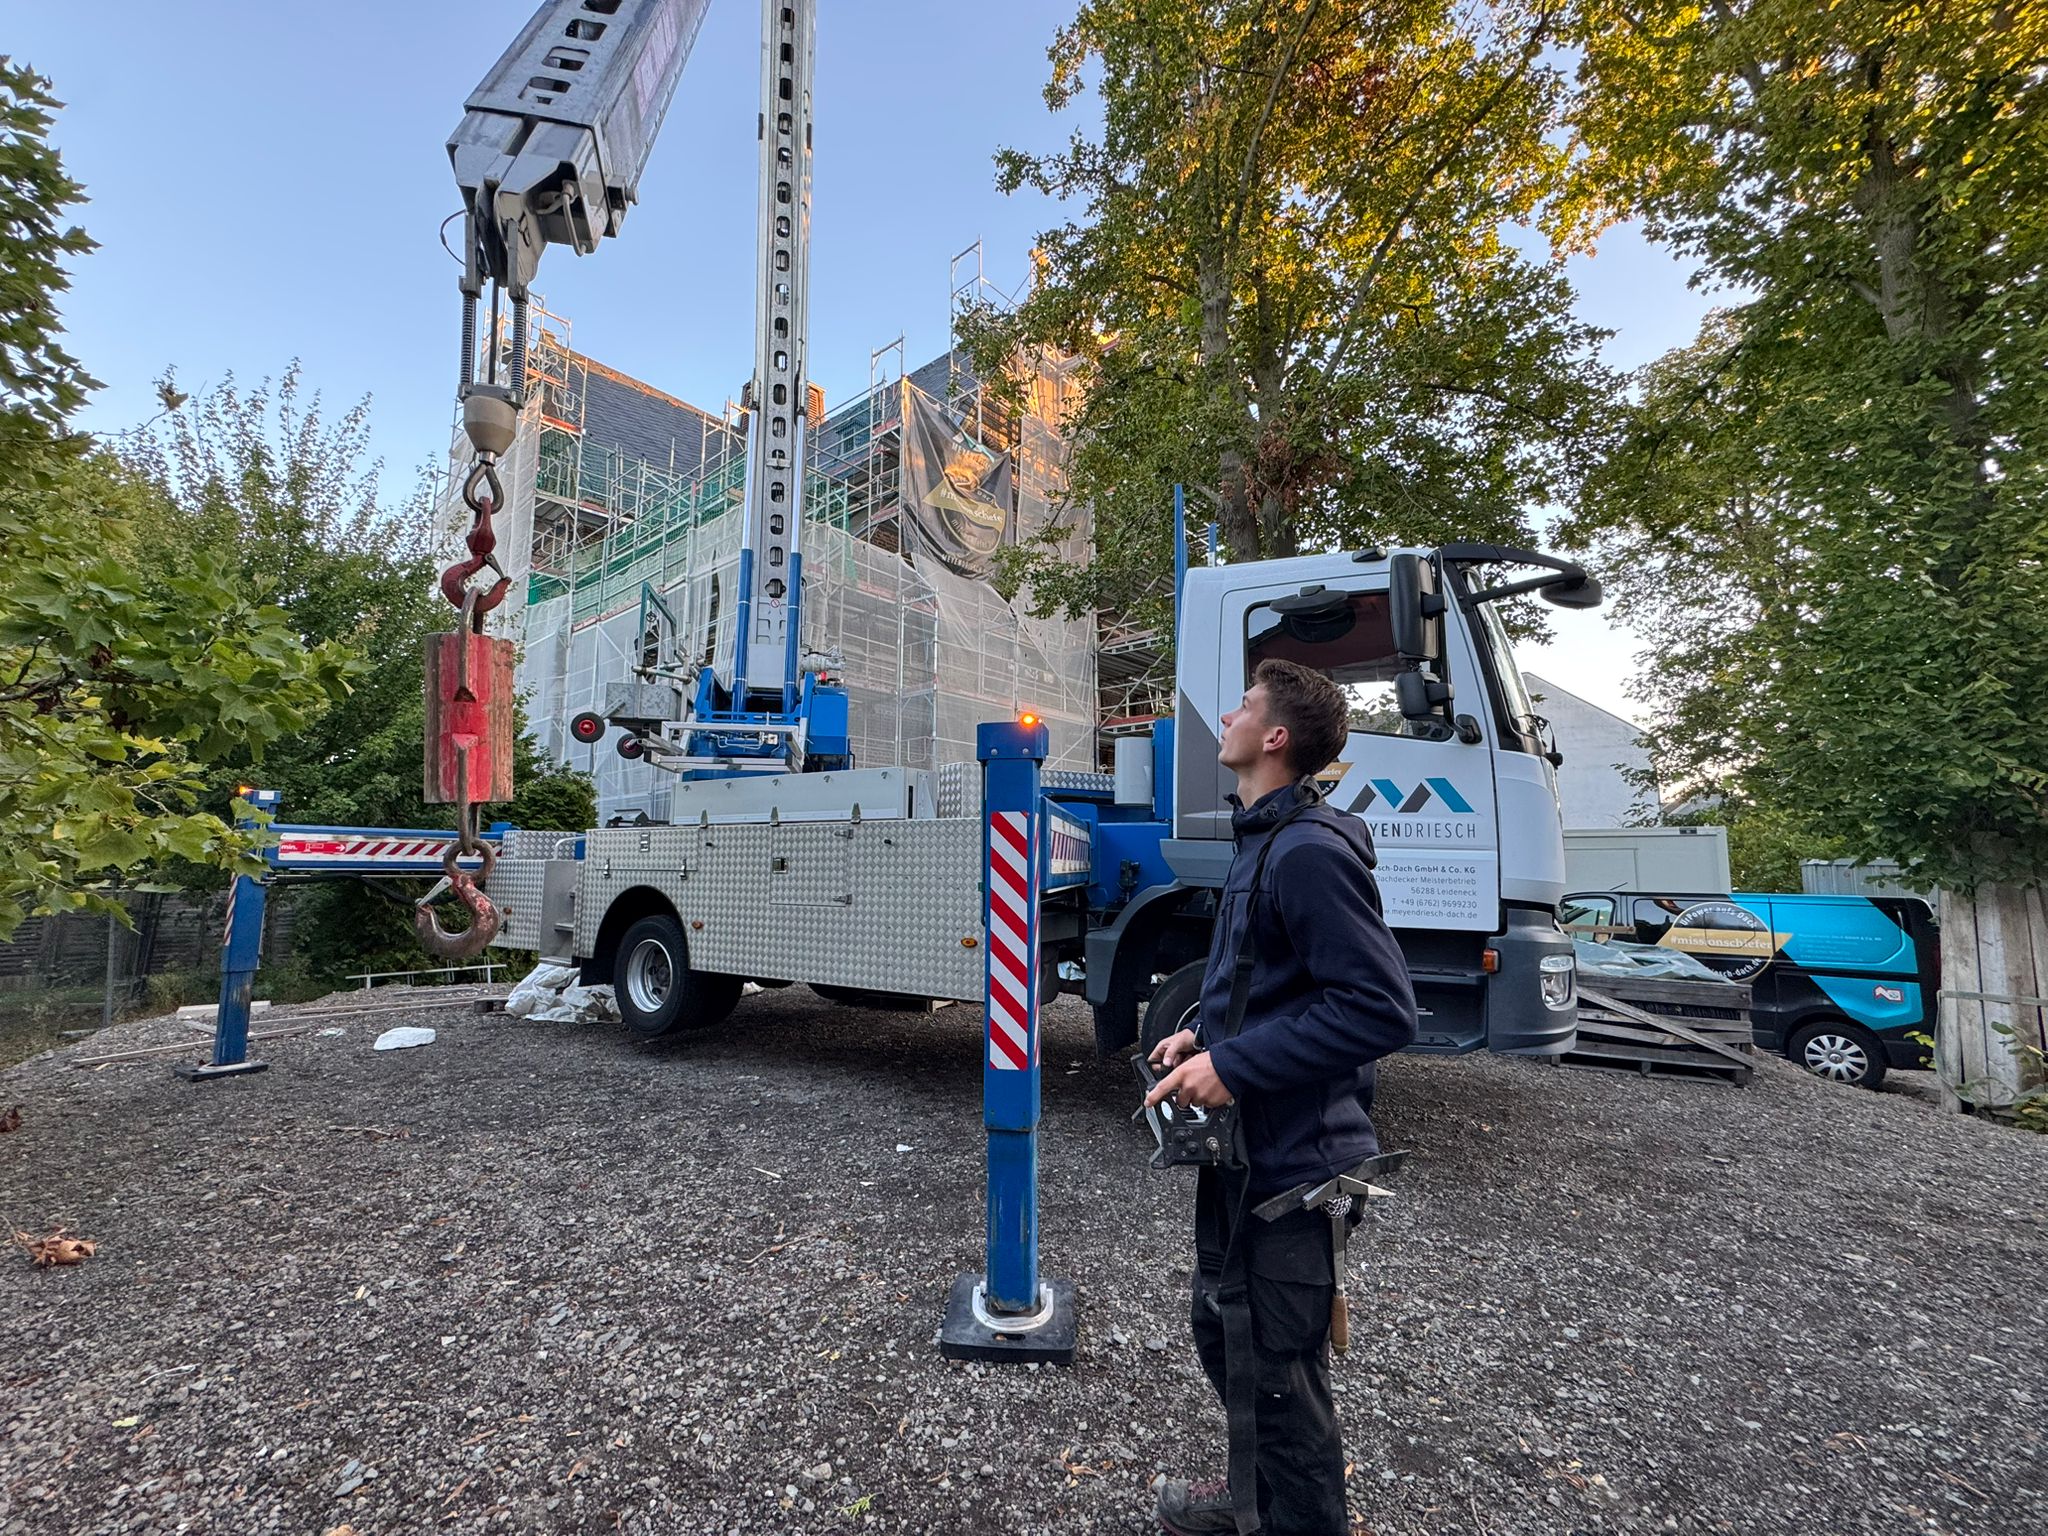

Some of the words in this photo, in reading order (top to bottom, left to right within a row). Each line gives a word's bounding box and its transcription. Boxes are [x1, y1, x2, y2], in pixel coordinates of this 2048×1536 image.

[1369, 823, 1476, 838] YENDRIESCH
[1414, 865, 1439, 873] GmbH
[1464, 866, 1476, 874] KG
[1376, 875, 1418, 883] Dachdecker
[1420, 876, 1477, 885] Meisterbetrieb
[1410, 886, 1435, 895] 56288
[1437, 887, 1477, 896] Leideneck
[1400, 898, 1415, 906] +49
[1416, 898, 1440, 907] (6762)
[1441, 900, 1478, 909] 9699230
[1384, 908, 1478, 919] w.meyendriesch-dach.de
